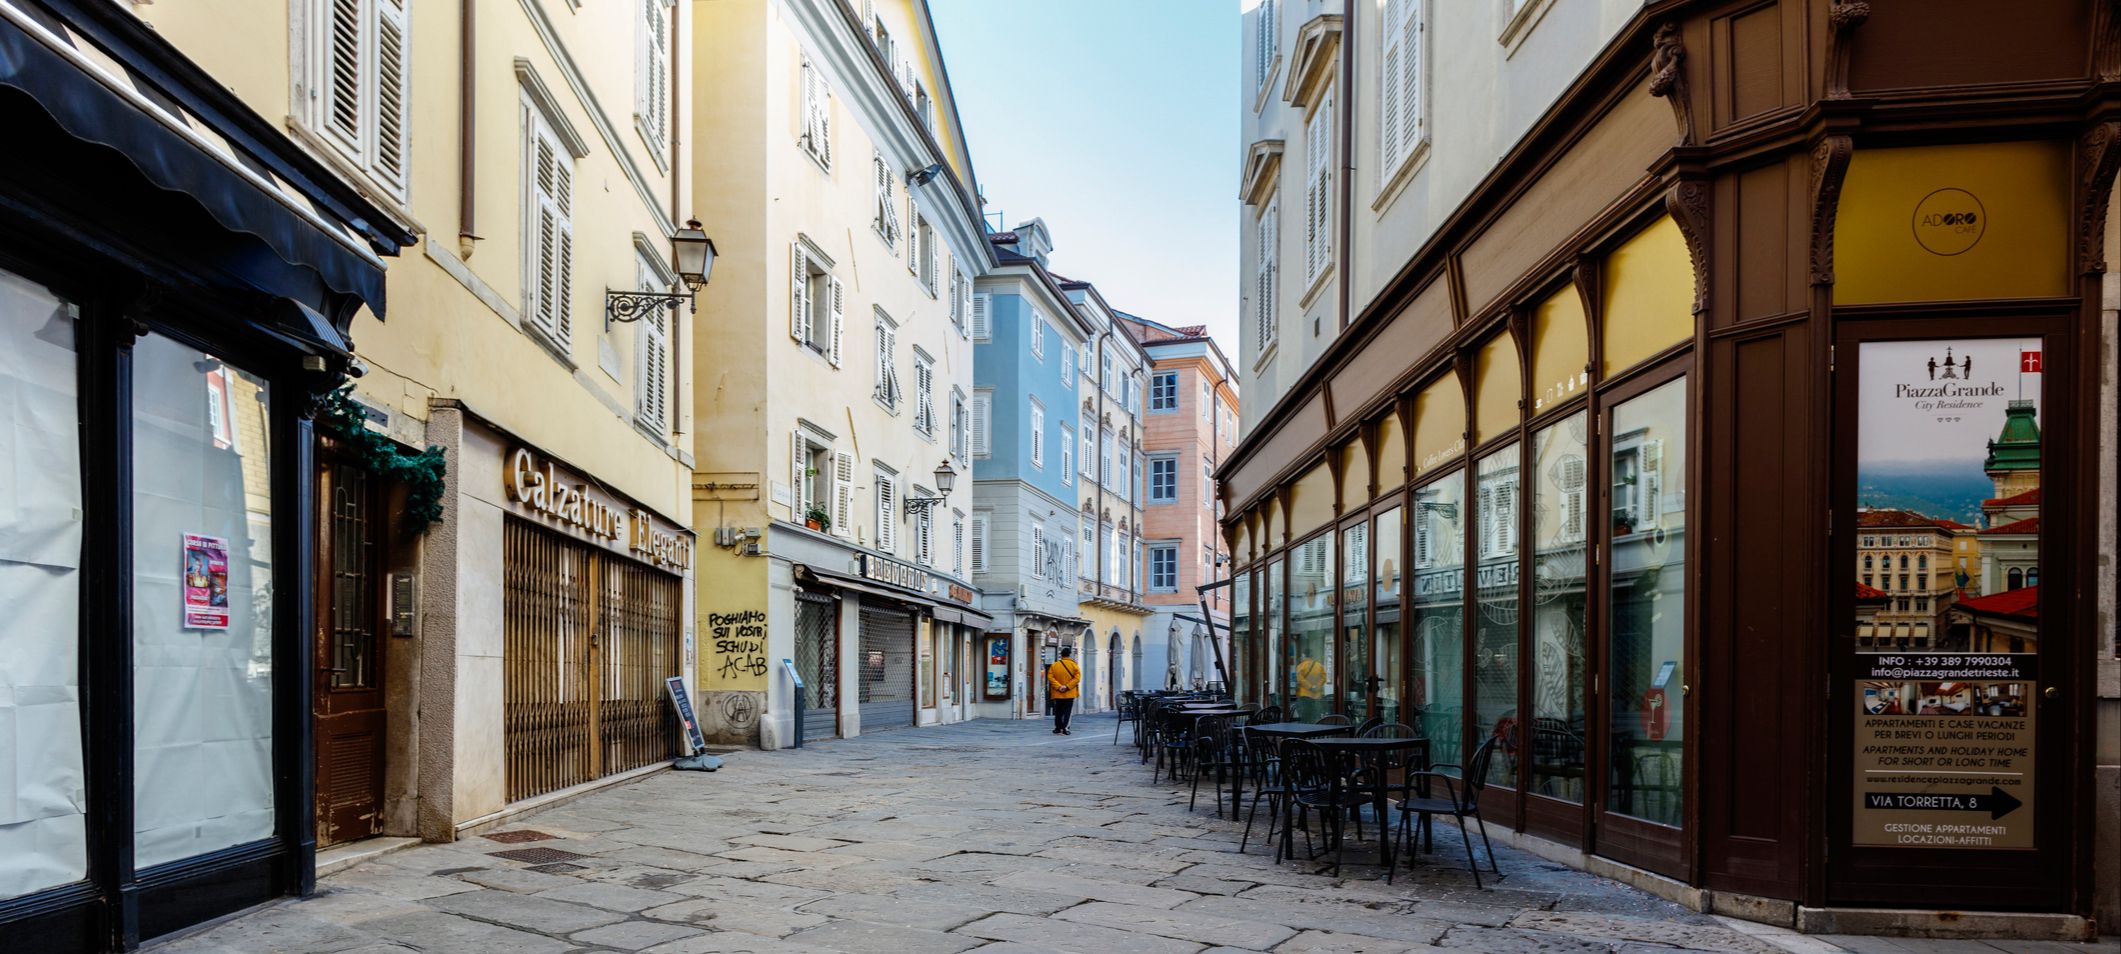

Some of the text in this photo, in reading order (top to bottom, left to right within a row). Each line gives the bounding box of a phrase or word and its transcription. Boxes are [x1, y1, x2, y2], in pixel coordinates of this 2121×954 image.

[1920, 212, 1977, 227] ADORO
[1895, 381, 2005, 398] PiazzaGrande
[1914, 399, 1984, 412] City Residence
[513, 447, 691, 570] Calzature Eleganti
[717, 653, 768, 679] ACAB
[1878, 656, 1905, 666] INFO
[1915, 656, 1939, 666] +39
[1940, 656, 1962, 666] 389
[1964, 656, 2012, 666] 7990304
[1871, 667, 2020, 679] info@piazzagrandetrieste.it
[1864, 719, 2026, 730] APPARTAMENTI E CASE VACANZE
[1874, 730, 2015, 741] PER BREVI O LUNGHI PERIODI
[1862, 745, 2028, 757] APARTMENTS AND HOLIDAY HOME
[1878, 757, 2012, 768] FOR SHORT OR LONG TIME
[1866, 775, 2022, 787] www.residencepiazzagrande.com
[1871, 795, 1978, 809] VIA TORRETTA, 8
[1884, 823, 2007, 836] GESTIONE APPARTAMENTI
[1897, 834, 1992, 846] LOCAZIONI-AFFITTI
